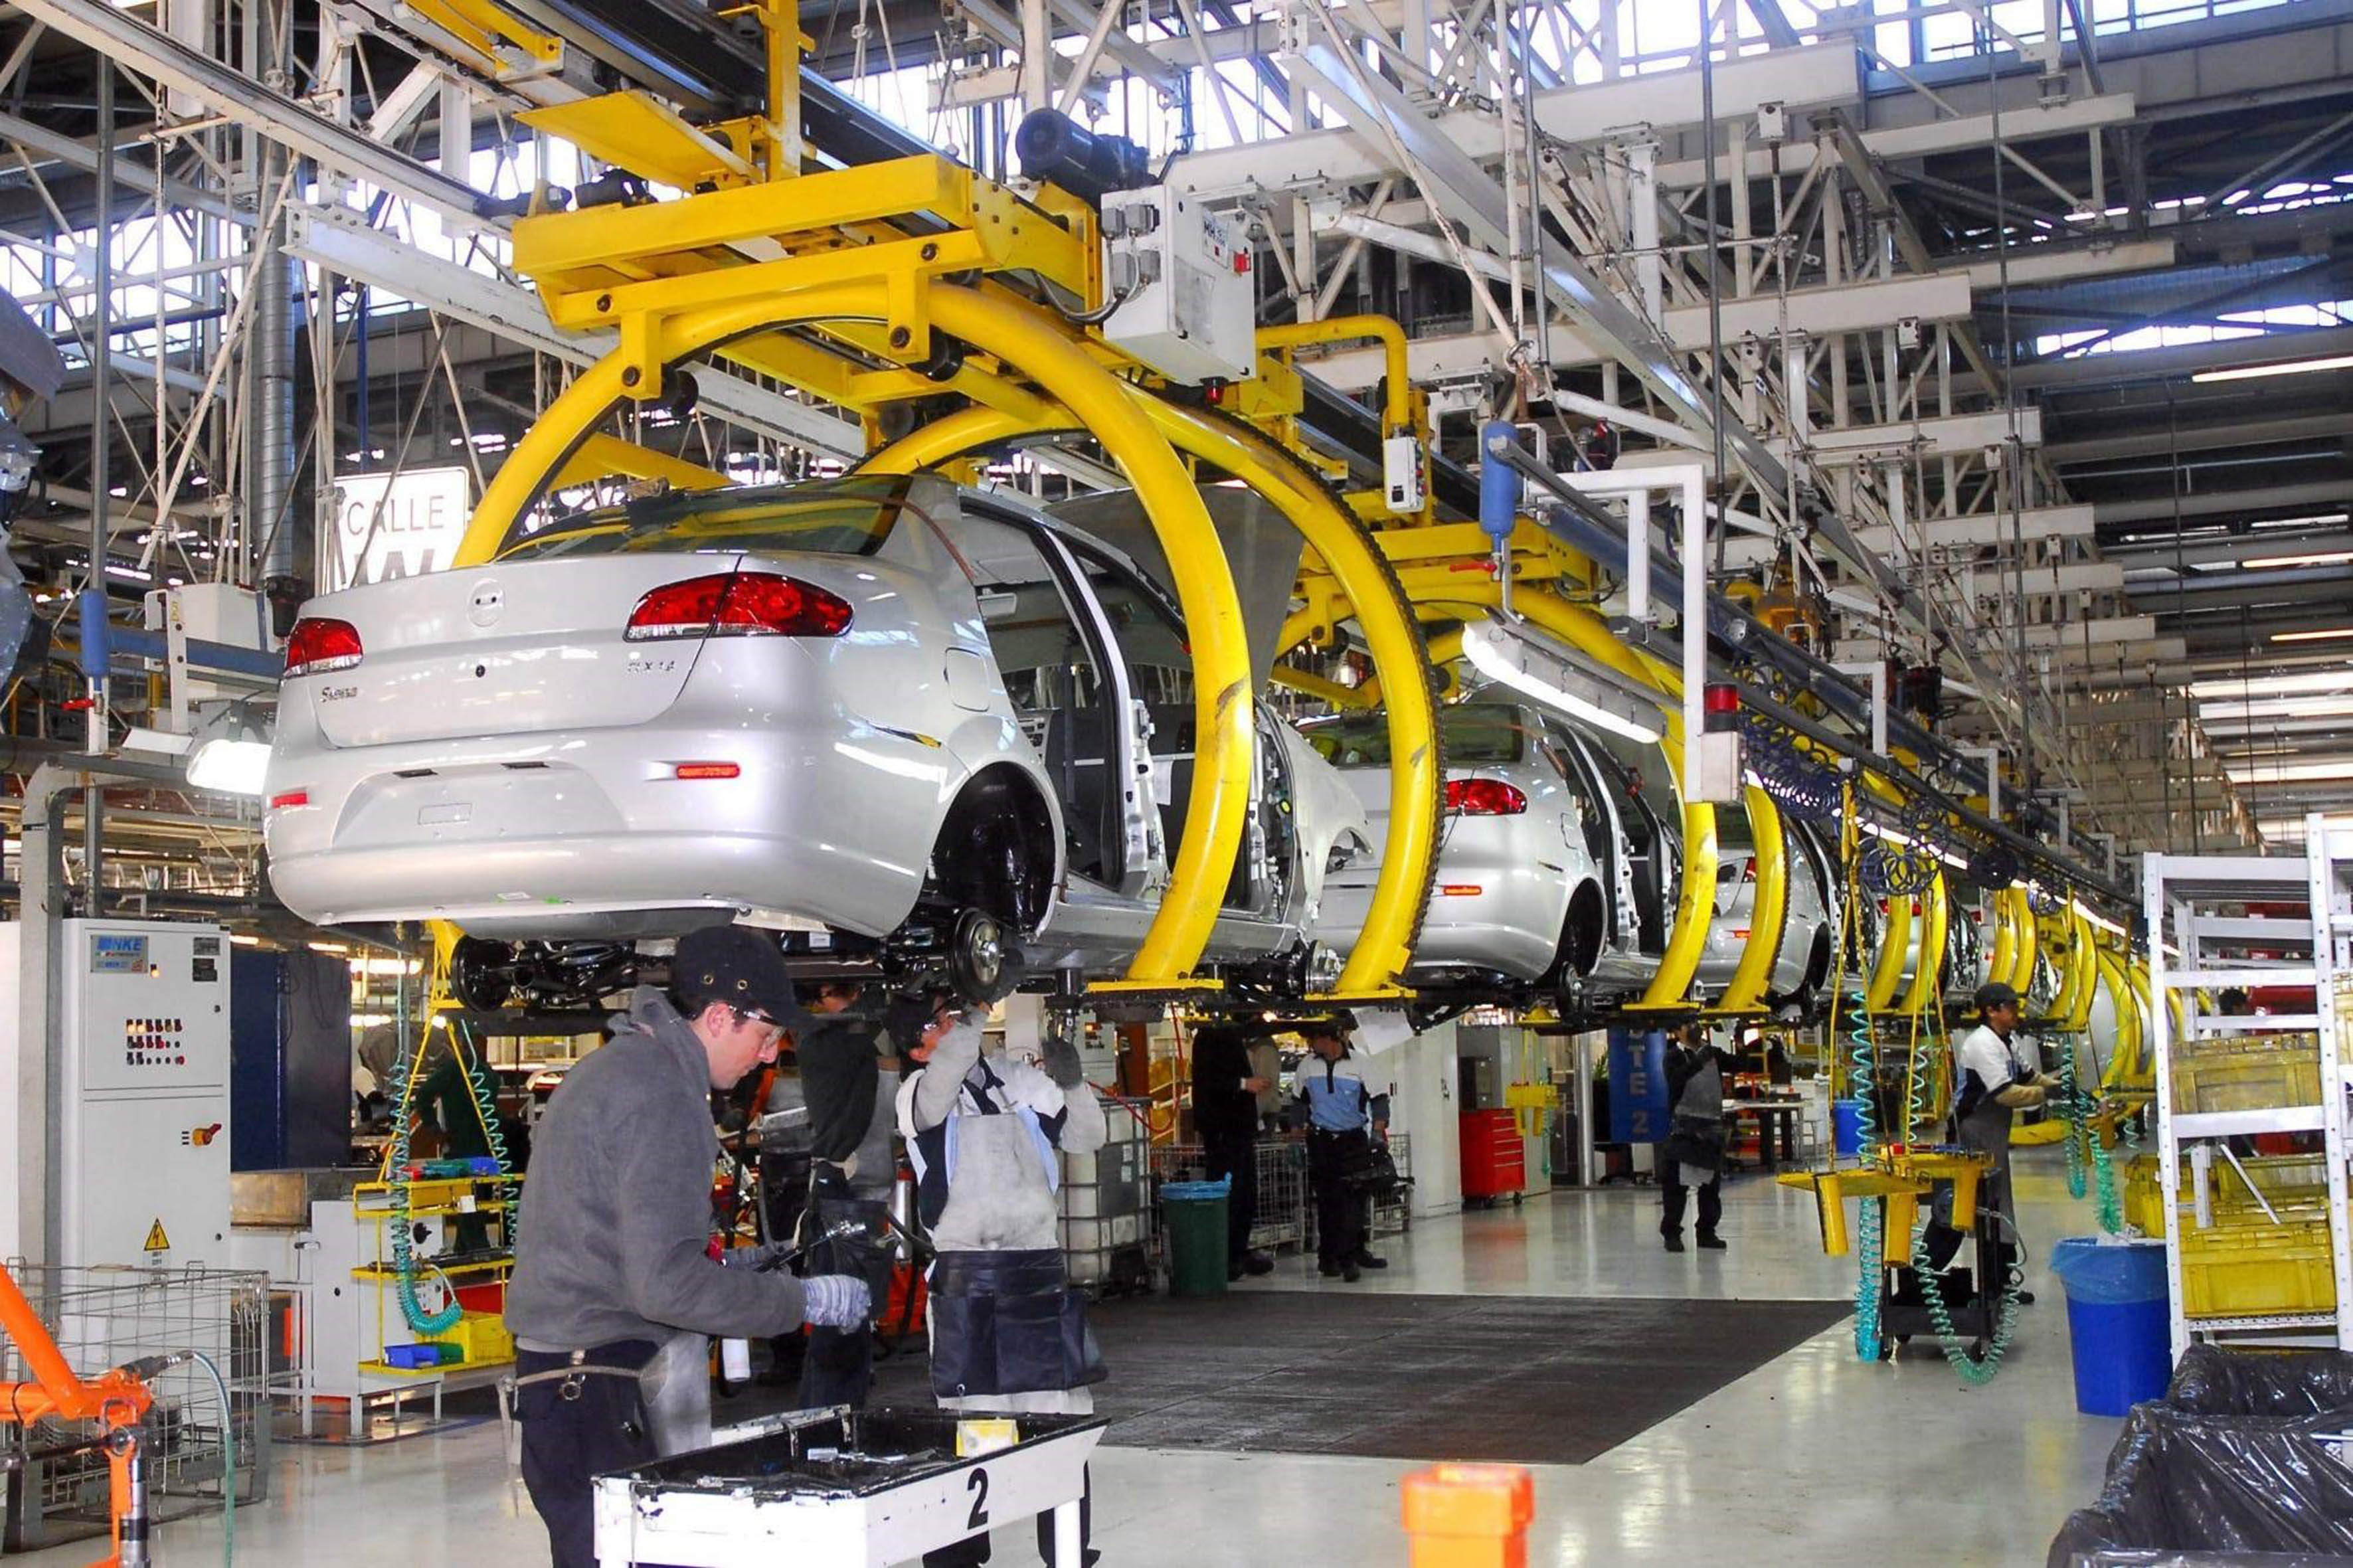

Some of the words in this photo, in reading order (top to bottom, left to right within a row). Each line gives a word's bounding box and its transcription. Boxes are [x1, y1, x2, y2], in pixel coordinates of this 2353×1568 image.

[347, 495, 444, 536] CALLE
[1632, 1110, 1650, 1133] 2
[967, 1467, 989, 1530] 2
